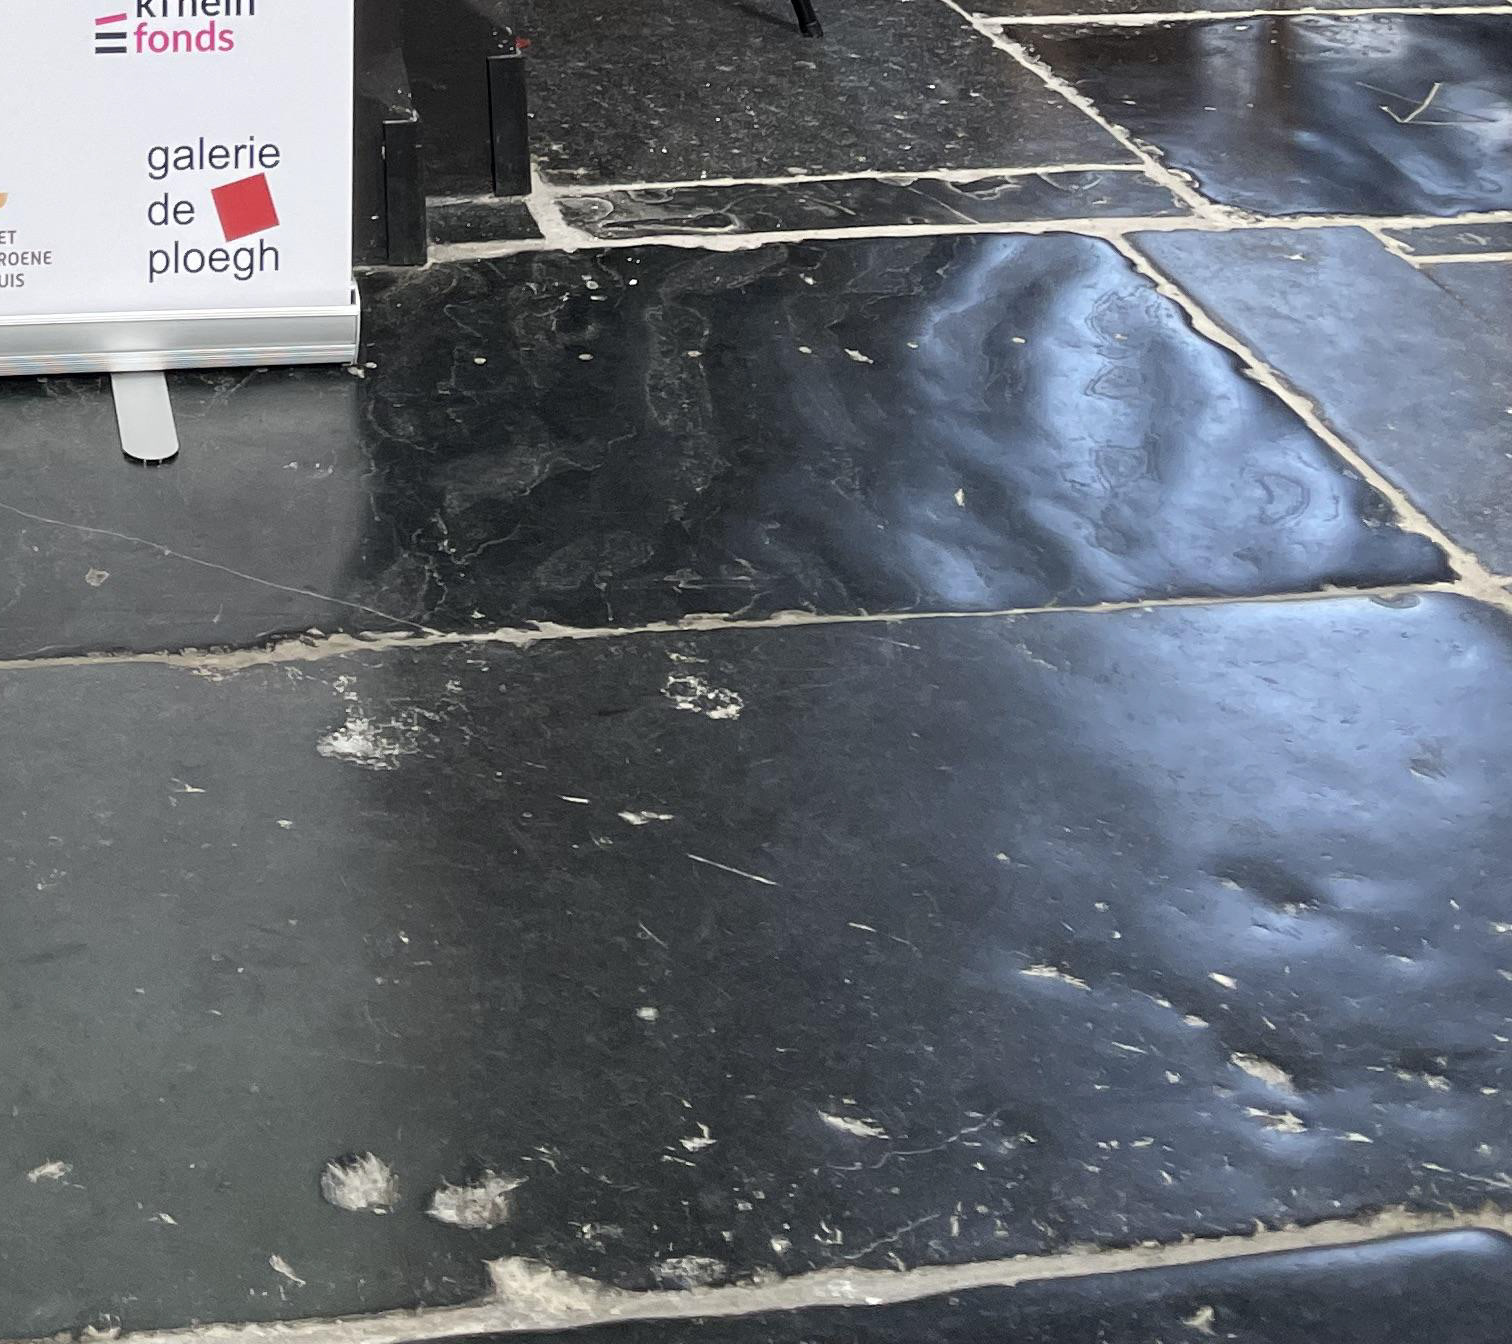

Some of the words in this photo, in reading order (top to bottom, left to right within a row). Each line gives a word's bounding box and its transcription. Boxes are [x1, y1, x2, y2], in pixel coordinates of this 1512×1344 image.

[133, 20, 234, 53] fonds
[148, 136, 280, 181] galerie
[148, 192, 195, 226] de
[149, 238, 279, 283] ploegh
